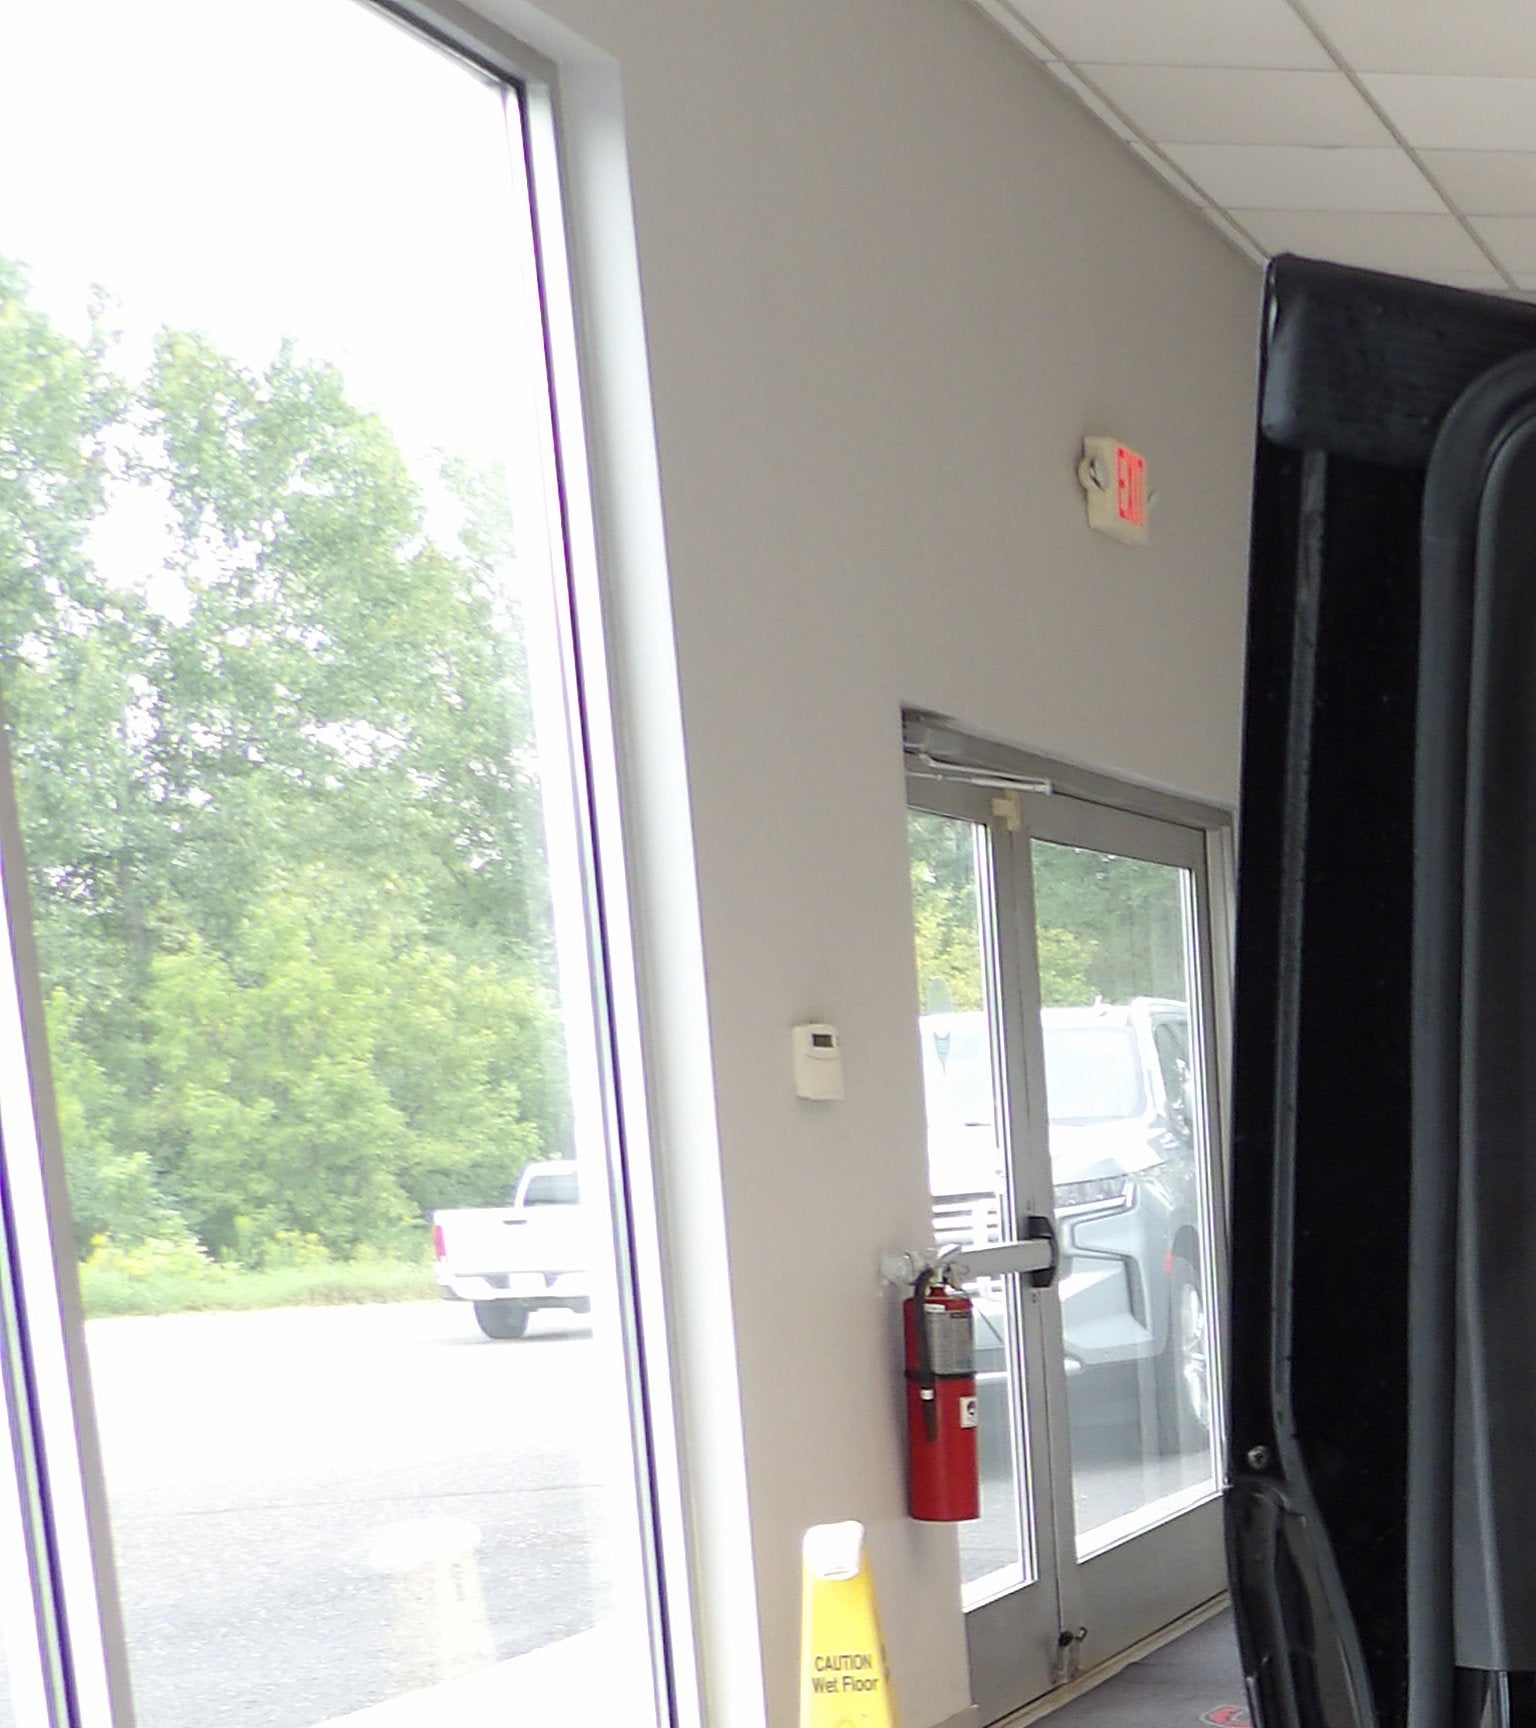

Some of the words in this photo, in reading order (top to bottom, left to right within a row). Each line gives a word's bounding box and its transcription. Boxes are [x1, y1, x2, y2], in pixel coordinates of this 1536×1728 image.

[815, 1654, 873, 1672] CAUTION
[811, 1677, 840, 1693] Wet
[842, 1675, 880, 1692] Floor
